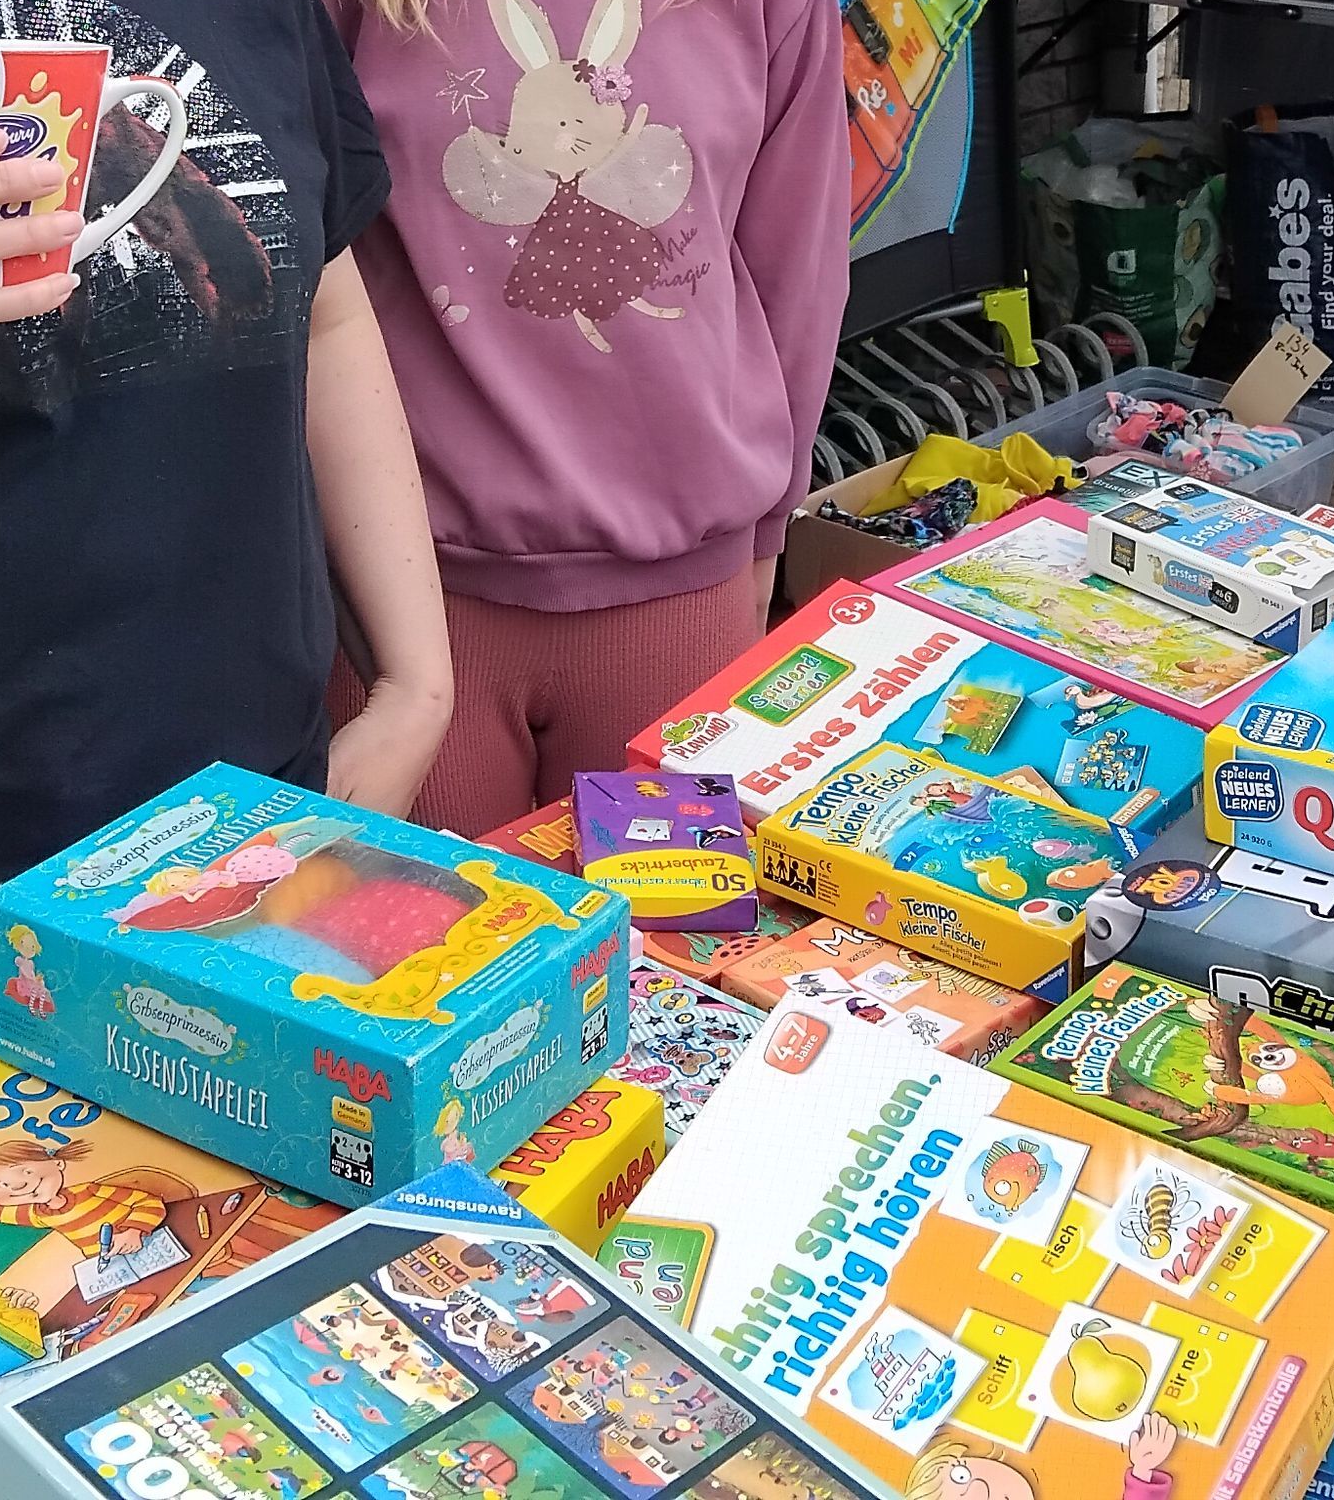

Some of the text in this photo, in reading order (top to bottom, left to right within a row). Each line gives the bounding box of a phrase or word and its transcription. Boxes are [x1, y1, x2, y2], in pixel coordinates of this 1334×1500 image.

[5, 125, 36, 144] bury
[1318, 193, 1334, 237] deal.
[661, 227, 698, 270] Make
[650, 262, 711, 297] magic
[1180, 519, 1235, 547] Erstes
[1168, 565, 1199, 584] Erstes
[835, 598, 868, 622] 3+
[677, 715, 732, 762] PLAYLAND
[1263, 709, 1295, 746] NEUES
[738, 717, 858, 797] Erstes
[1220, 765, 1271, 784] spielend
[825, 801, 876, 847] kleine
[864, 759, 931, 811] Fische!
[1221, 780, 1275, 799] NEUES
[1224, 796, 1276, 812] LERNEN
[80, 807, 217, 889] Erbsenprinzessin
[620, 857, 729, 875] Zaubertricks
[711, 873, 746, 892] 50
[481, 900, 533, 932] HABA
[900, 897, 963, 929] Tempo,
[900, 919, 987, 951] kleine Fische!
[570, 931, 620, 990] HABA
[130, 991, 229, 1052] Erbsenprinzessin
[775, 1018, 807, 1063] 4-7
[1045, 1009, 1106, 1062] Tempo,
[1074, 984, 1187, 1095] kleines Faultier!
[455, 1021, 536, 1088] Erbsenprinzessin
[793, 1033, 819, 1063] Jahre
[313, 1045, 391, 1103] HABA
[339, 1101, 366, 1118] Made in
[498, 1090, 621, 1176] HABA
[396, 1192, 522, 1220] Ravensburger
[596, 1146, 656, 1229] HABA
[764, 1128, 964, 1397] richtig hören
[1041, 1222, 1079, 1269] Fisch
[710, 1263, 817, 1372] chtig
[977, 1352, 1013, 1405] Schiff
